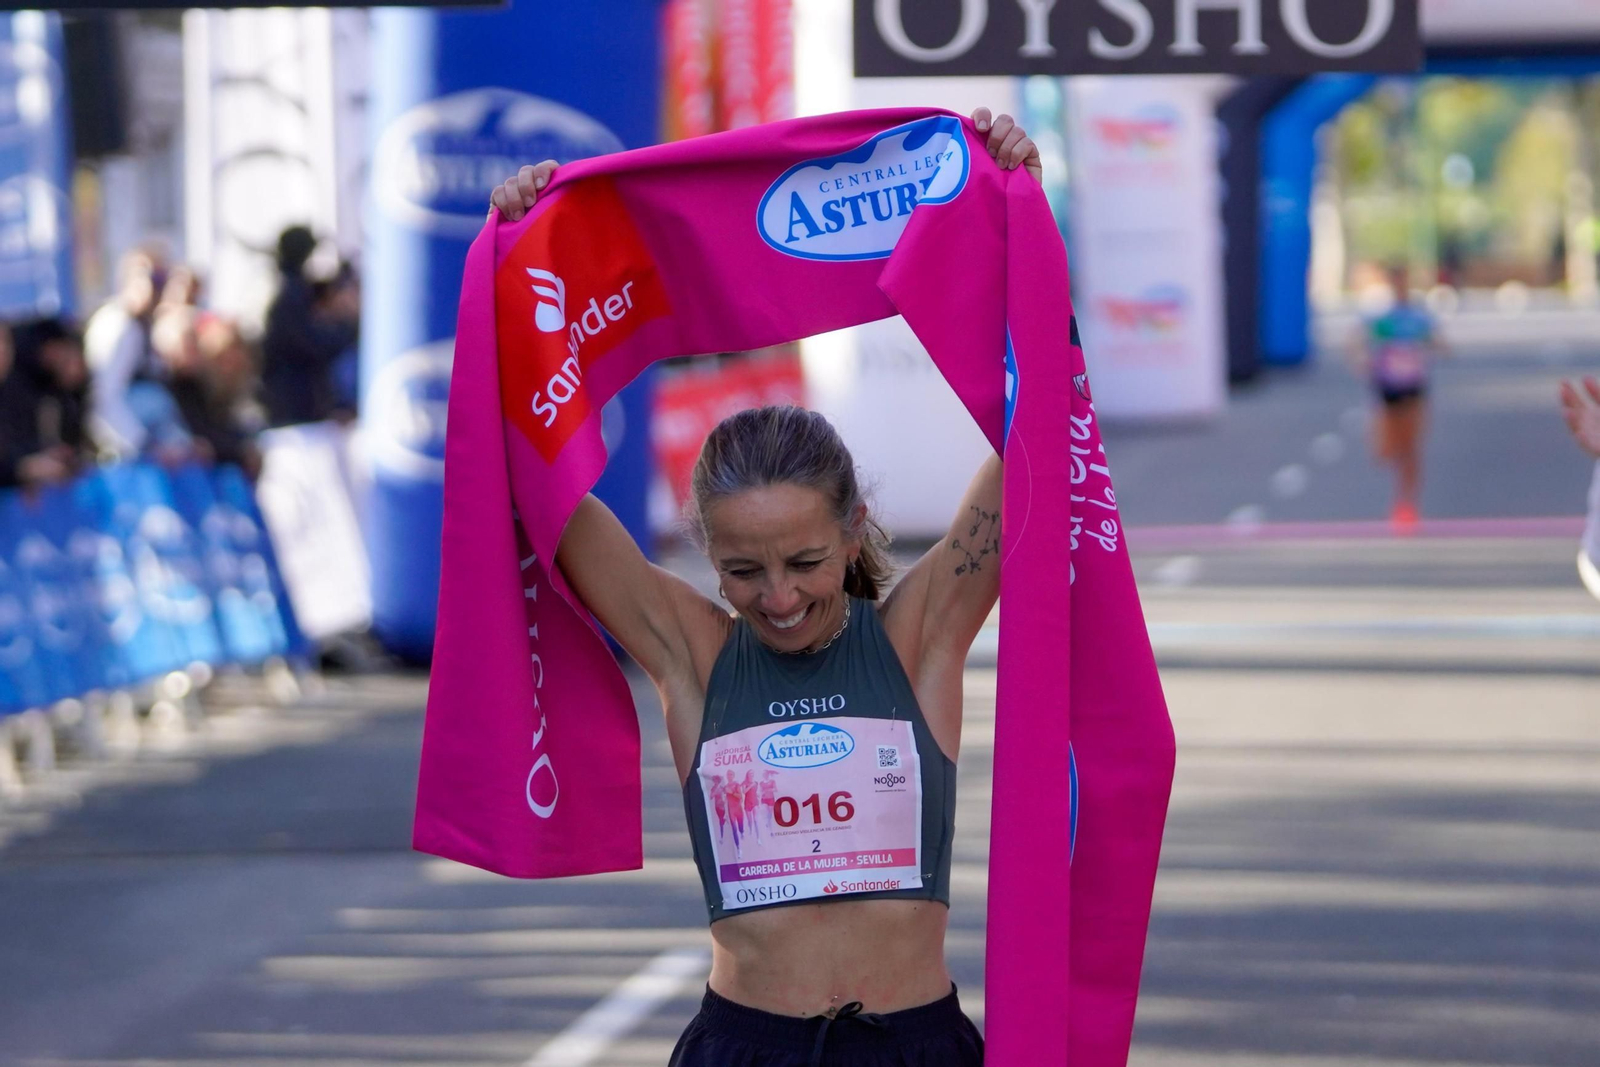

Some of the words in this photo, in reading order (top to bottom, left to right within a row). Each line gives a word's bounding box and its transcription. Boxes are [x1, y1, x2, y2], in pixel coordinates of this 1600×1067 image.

[873, 0, 1393, 62] OYSHO
[819, 164, 907, 193] CENTRAL
[532, 281, 634, 428] Sannder
[768, 694, 846, 717] OYSHO
[766, 741, 848, 760] ASTURIANA
[779, 738, 810, 746] CENTRAL
[714, 752, 752, 767] SUMA
[773, 791, 855, 827] 016
[812, 839, 821, 853] 2
[739, 863, 781, 877] CARRERA
[783, 861, 795, 872] DE
[798, 859, 811, 870] LA
[814, 857, 847, 869] MUJER
[856, 853, 893, 865] SEVILLA
[736, 883, 797, 903] OYSHO
[841, 879, 901, 892] Santander
